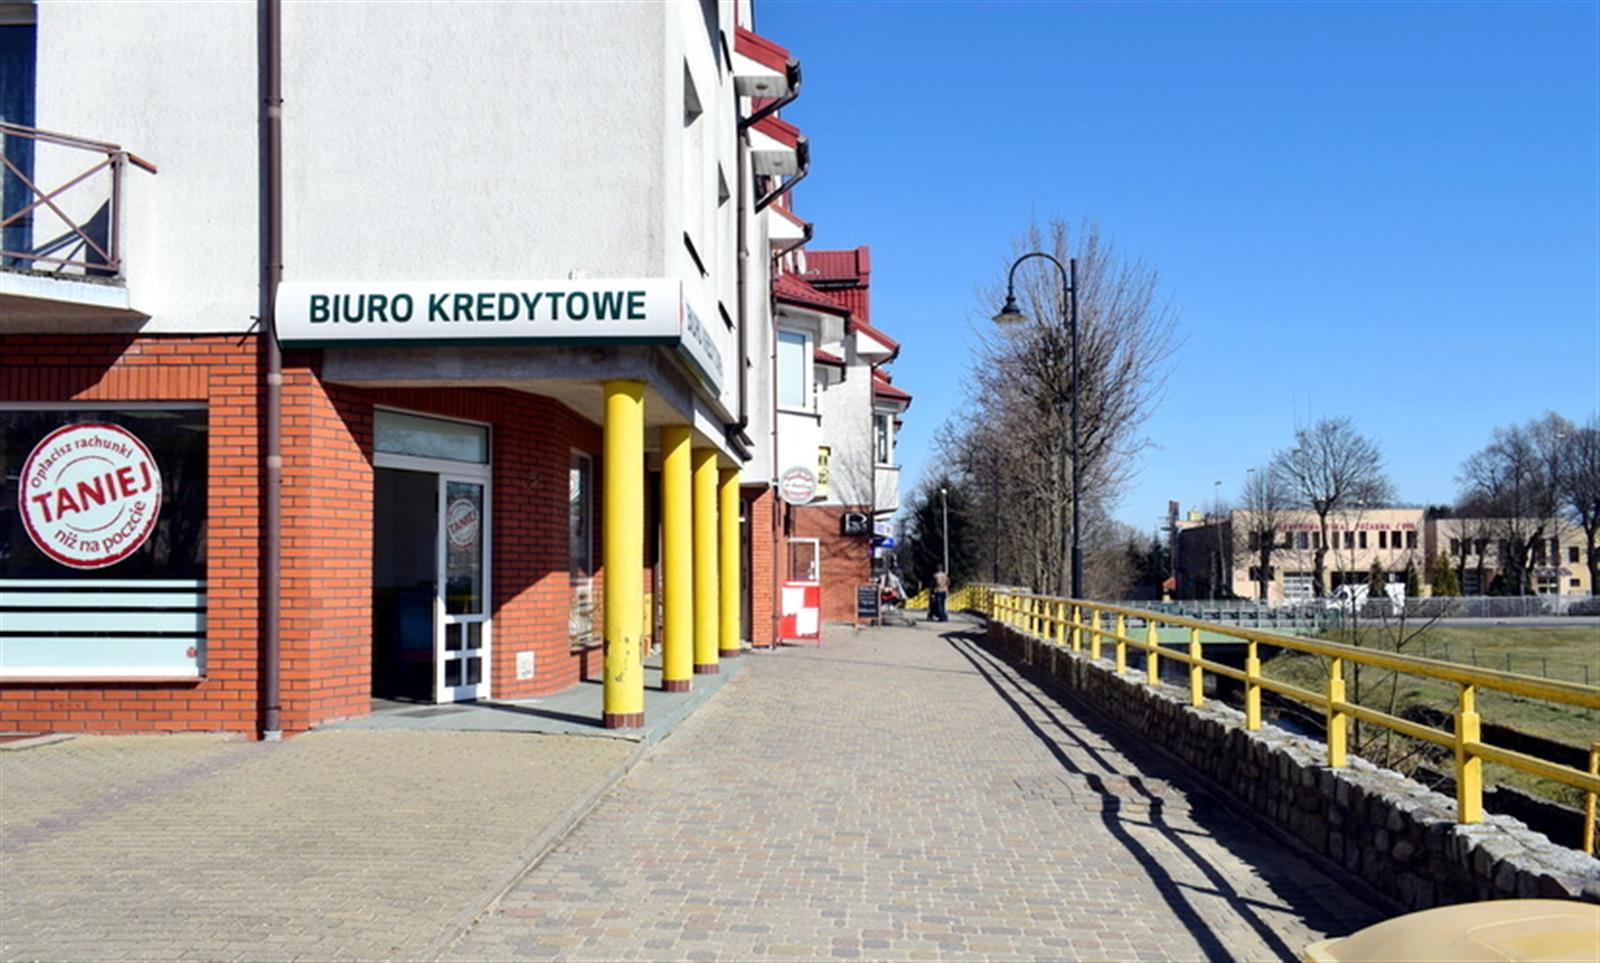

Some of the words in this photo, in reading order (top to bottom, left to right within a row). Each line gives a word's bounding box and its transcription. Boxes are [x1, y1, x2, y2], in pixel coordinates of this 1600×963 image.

[309, 292, 413, 324] BIURO
[428, 291, 646, 322] KREDYTOWE
[75, 435, 133, 459] rachunki
[32, 461, 152, 523] TANIEJ
[54, 529, 77, 549] niż
[80, 539, 100, 553] na
[102, 501, 146, 553] poczcie
